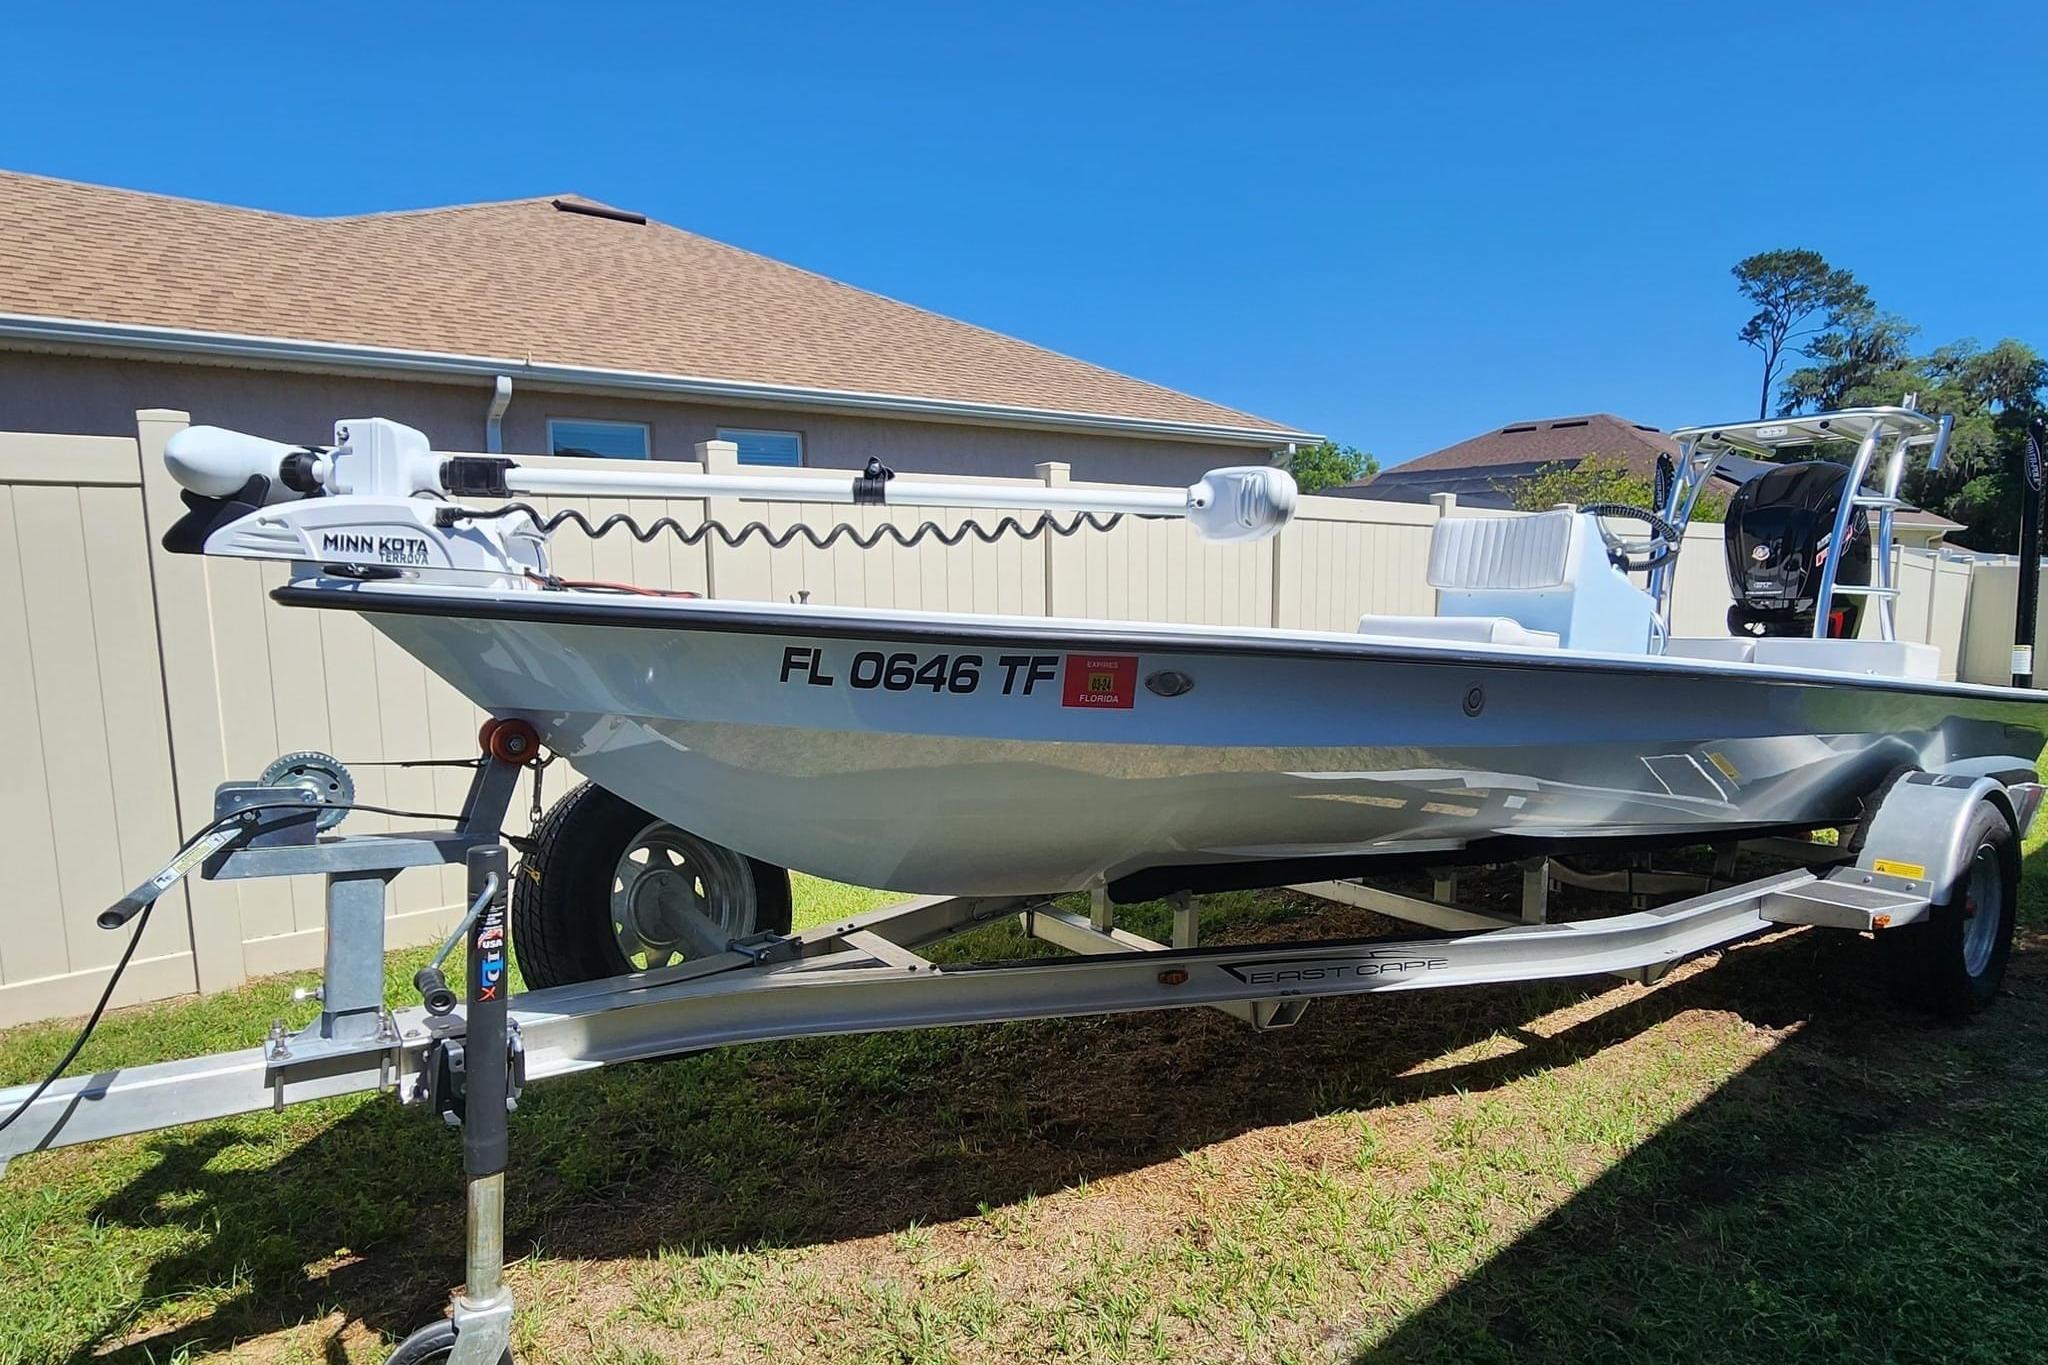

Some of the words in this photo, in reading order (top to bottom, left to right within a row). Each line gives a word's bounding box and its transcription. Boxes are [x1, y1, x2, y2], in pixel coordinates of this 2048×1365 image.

[322, 533, 374, 553] MINN
[379, 536, 429, 555] KOTA
[379, 552, 429, 565] TERROVA
[779, 646, 834, 686] FL
[849, 650, 983, 694] 0646
[998, 655, 1060, 696] TF
[1087, 660, 1119, 669] EXPIRES
[1079, 694, 1119, 704] FLORIDA
[482, 938, 503, 949] USA
[1250, 966, 1350, 985] EAST
[1355, 958, 1449, 977] CAPE
